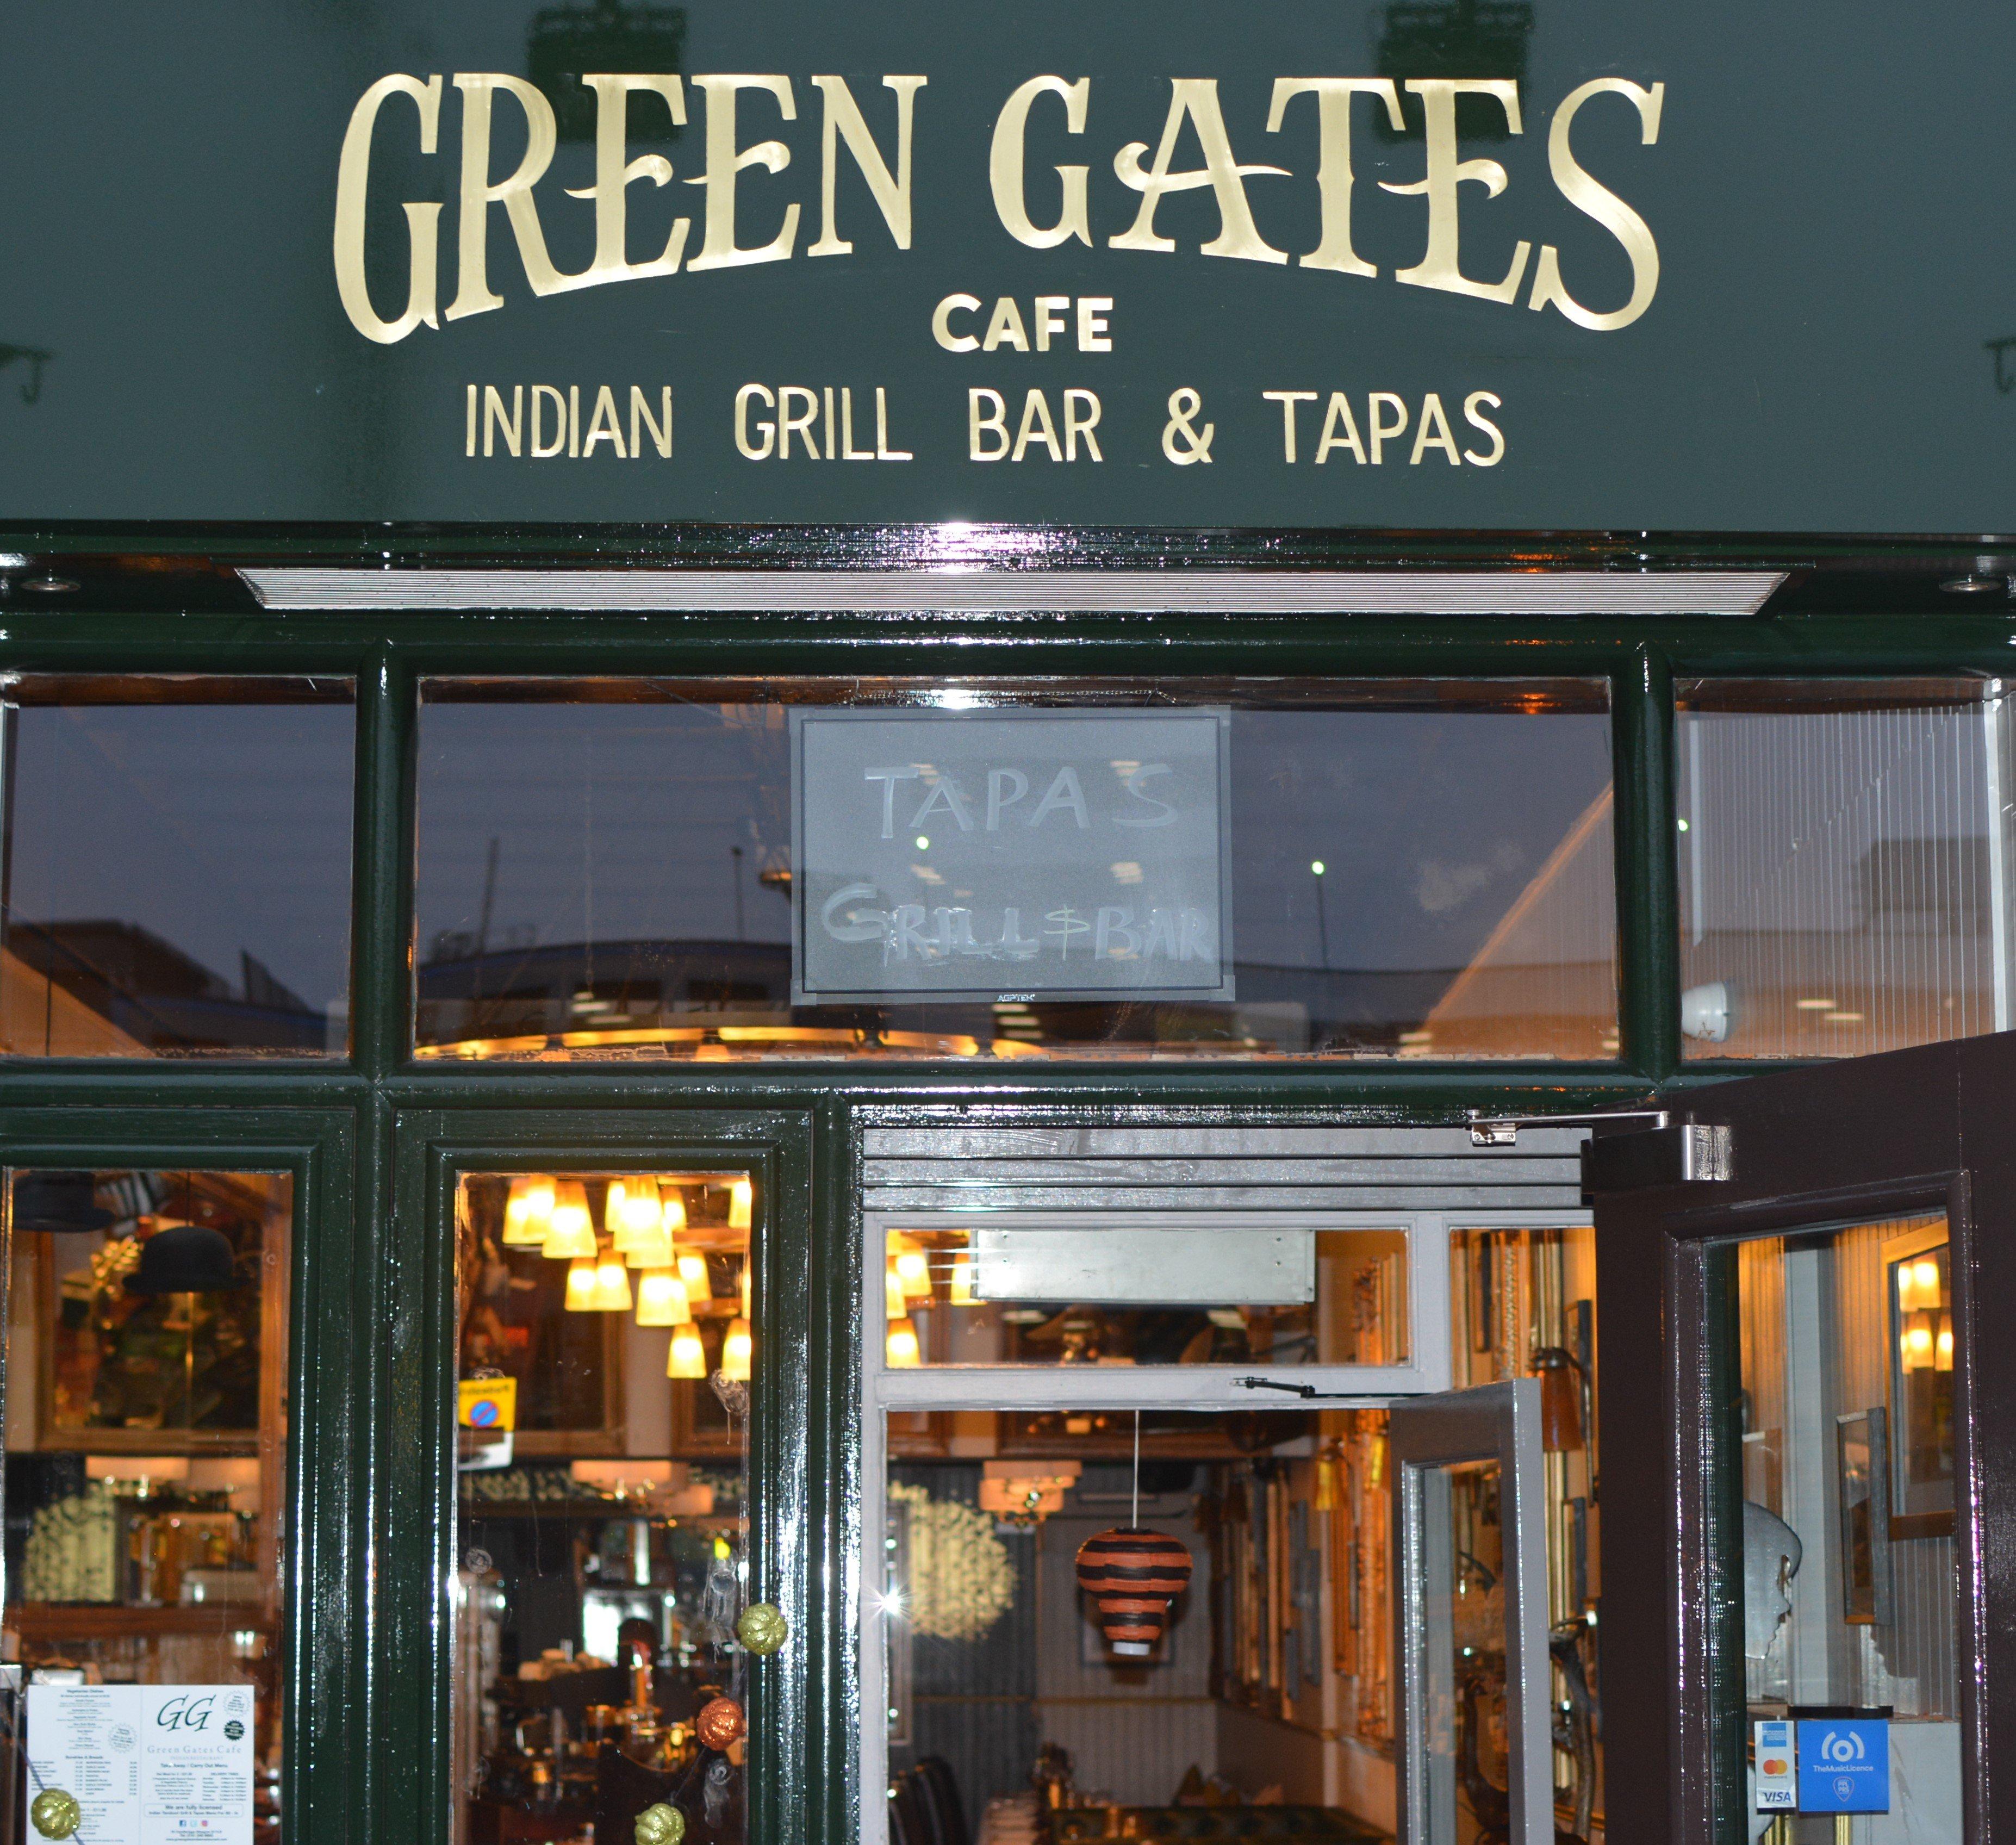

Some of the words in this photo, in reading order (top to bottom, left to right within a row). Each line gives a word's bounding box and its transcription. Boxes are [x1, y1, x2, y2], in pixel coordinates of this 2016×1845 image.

[334, 72, 928, 345] GREEN
[990, 74, 1664, 331] GATES
[932, 293, 1113, 352] CAFE
[466, 384, 673, 459] INDIAN
[734, 383, 913, 461] GRILL
[968, 388, 1103, 463] BAR
[1162, 387, 1214, 465] &
[1262, 391, 1505, 467] TAPAS
[864, 762, 1179, 839] TAPAS
[822, 882, 1041, 965] GRILL
[1094, 905, 1215, 963] BAR
[157, 1694, 216, 1732] GG
[147, 1745, 179, 1754] Green
[183, 1745, 214, 1754] Gates
[217, 1744, 242, 1754] Cafe
[1763, 1792, 1791, 1802] VISA
